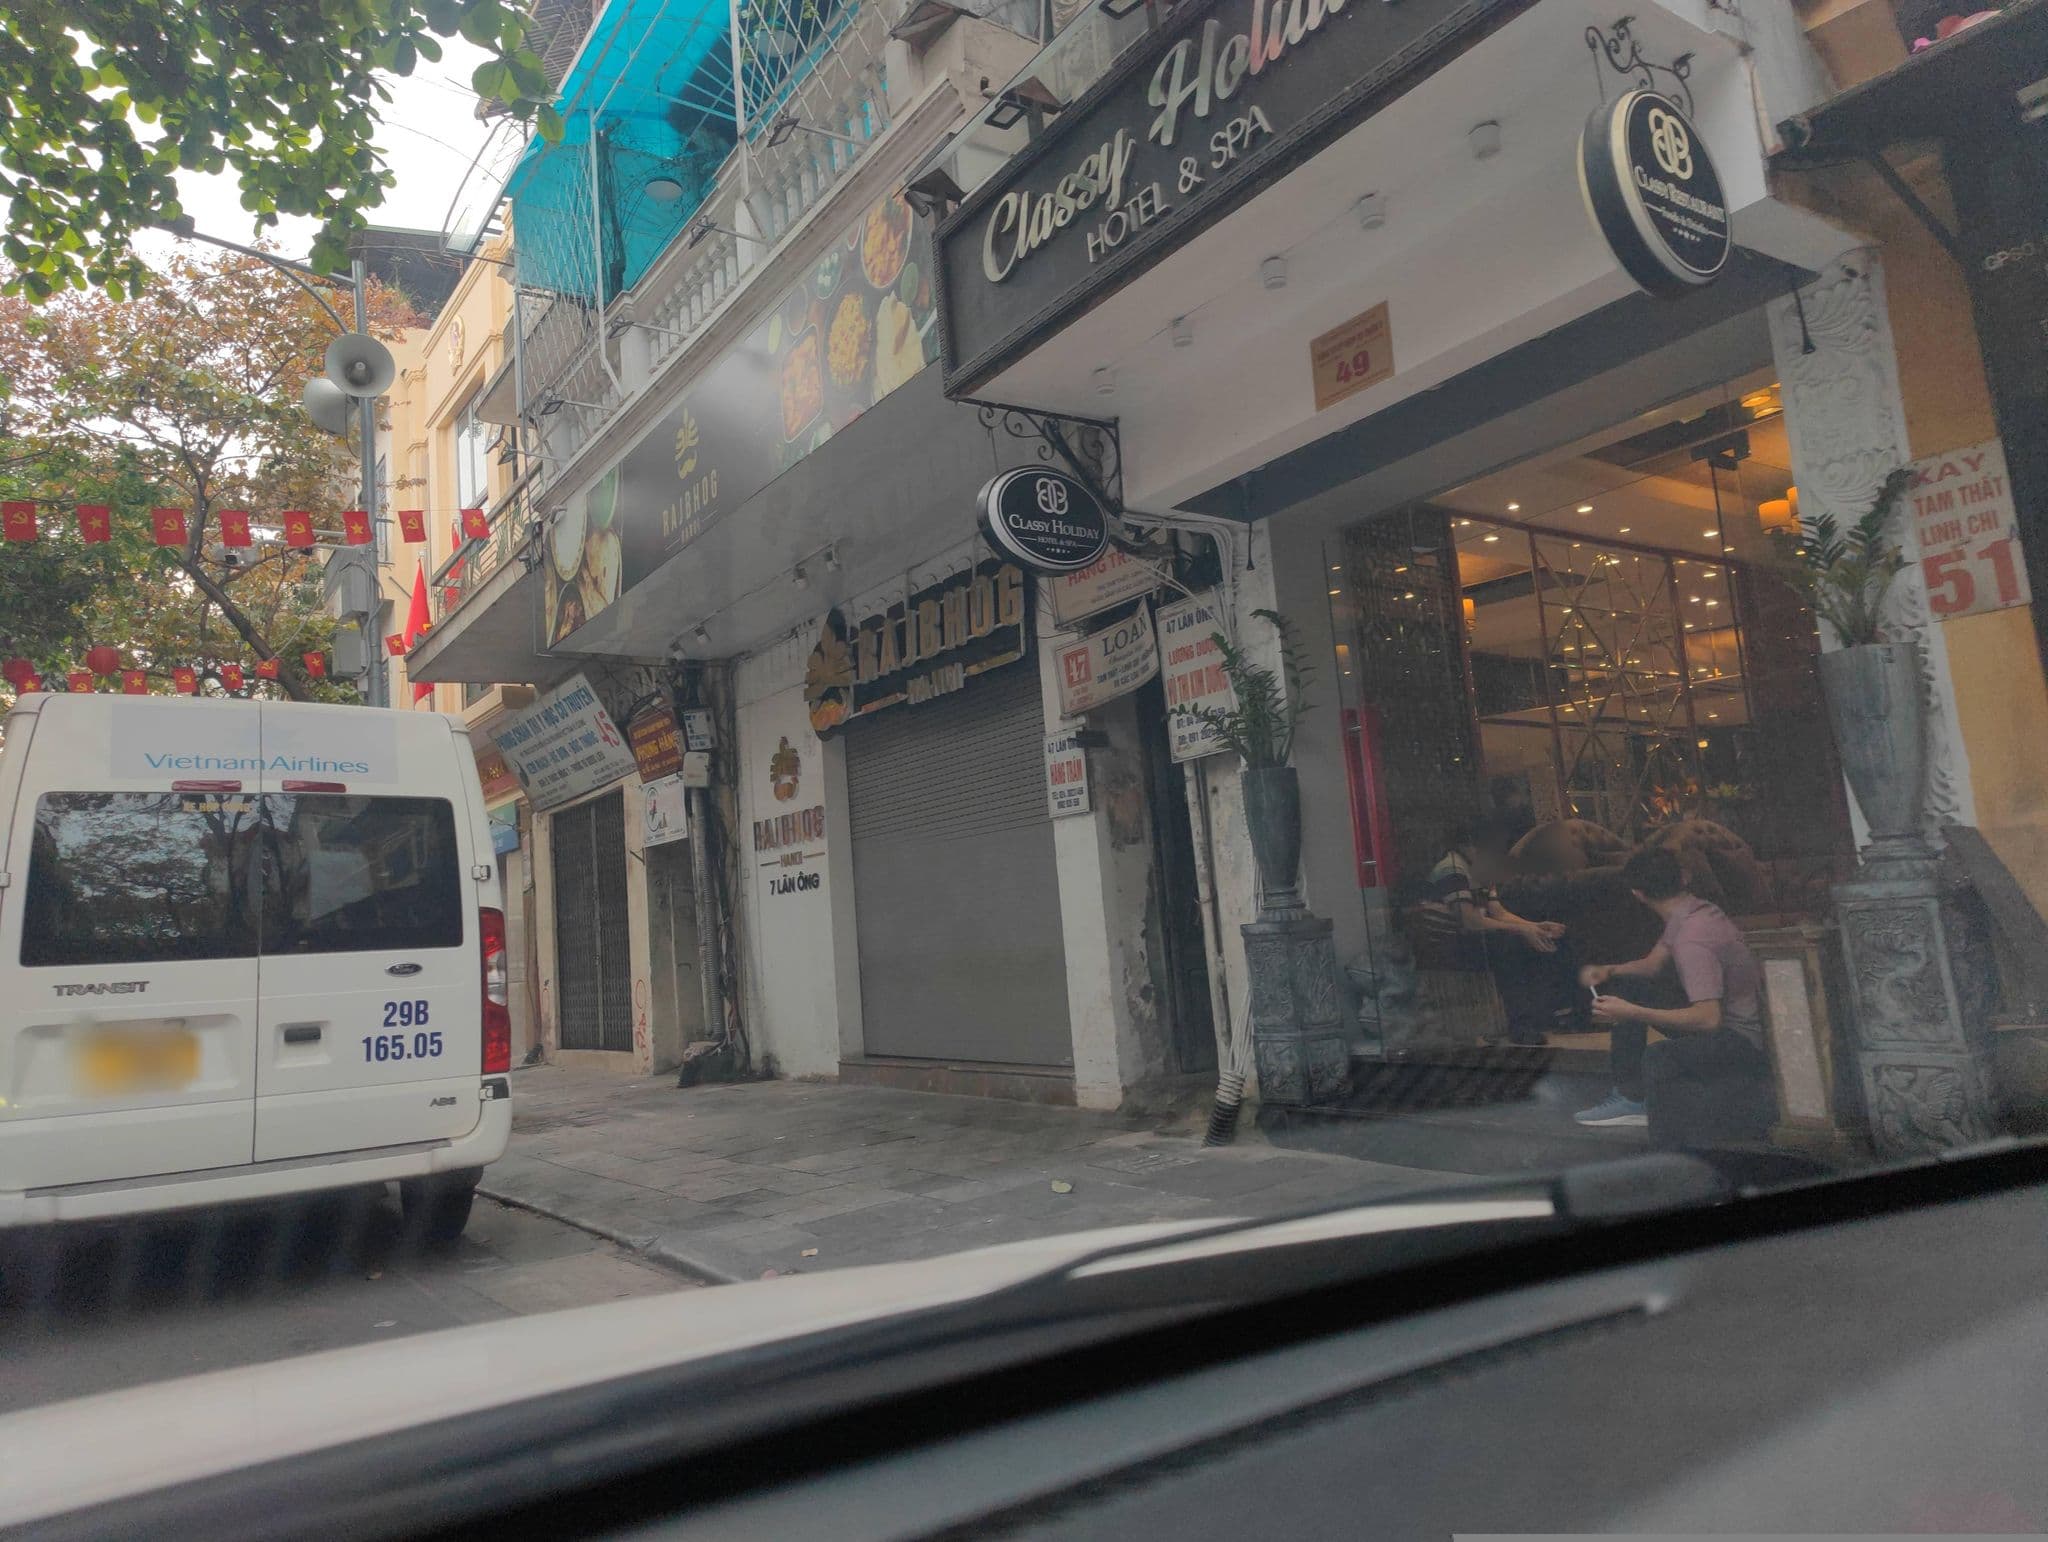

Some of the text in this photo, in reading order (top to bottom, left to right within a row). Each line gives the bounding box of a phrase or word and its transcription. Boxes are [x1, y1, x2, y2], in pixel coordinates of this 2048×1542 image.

[982, 0, 1350, 282] Classy Holi
[1087, 105, 1273, 263] HOTEL & SPA
[1336, 350, 1371, 384] 49
[662, 469, 718, 538] RAJBHOG
[1008, 514, 1101, 539] CLASSY HOLIDAY
[1919, 510, 2000, 547] LINH CHI
[1922, 538, 2021, 615] 51
[857, 563, 1025, 685] RAJBHOG
[1102, 612, 1148, 657] LOAN
[1068, 654, 1087, 683] 47
[144, 752, 369, 774] Vietnam Airlines
[769, 880, 776, 896] 7
[797, 871, 820, 891] ÔNG
[53, 981, 150, 997] TRANSIT
[384, 1000, 429, 1027] 29B
[362, 1032, 443, 1062] 165.05
[430, 1097, 457, 1107] ABS
